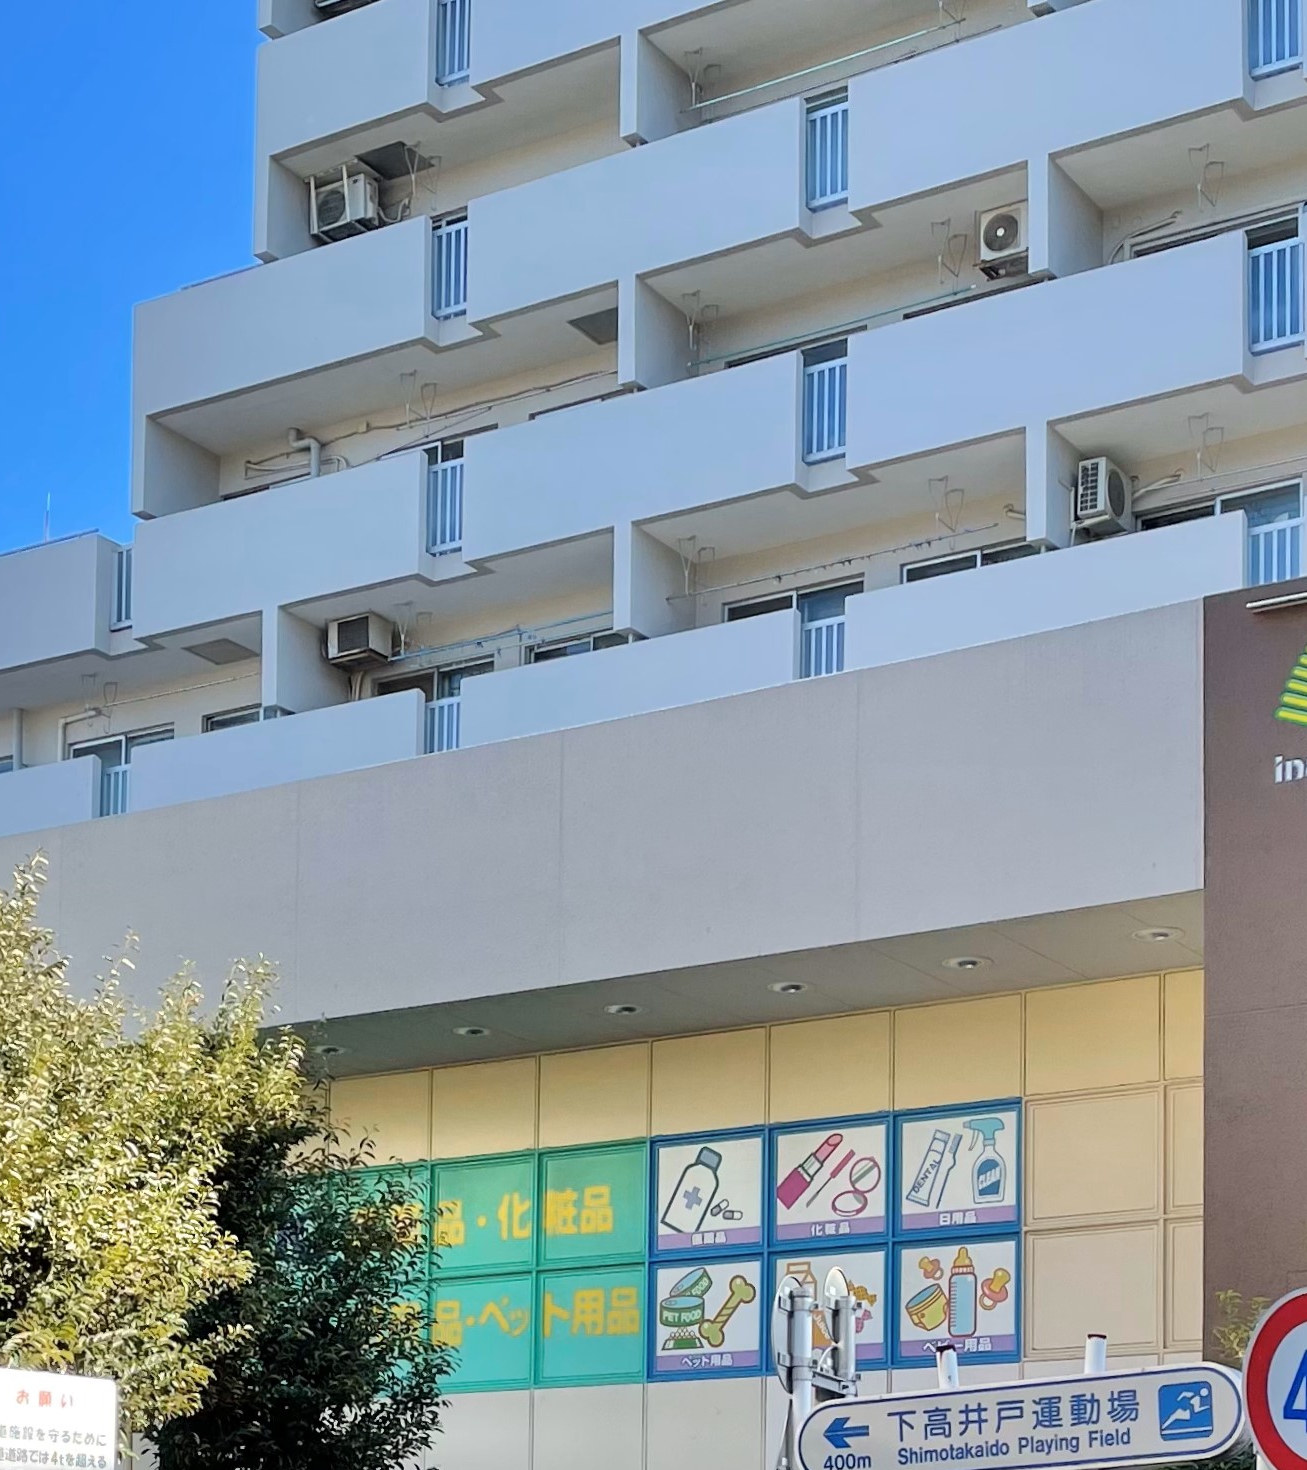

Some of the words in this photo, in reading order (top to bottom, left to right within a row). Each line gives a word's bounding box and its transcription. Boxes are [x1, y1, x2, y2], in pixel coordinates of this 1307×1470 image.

[912, 1159, 942, 1195] DENTAL
[939, 1211, 977, 1225] 日用品
[810, 1221, 850, 1236] 化粧品
[662, 1310, 680, 1322] PET
[681, 1309, 701, 1322] FOOD
[682, 1353, 733, 1367] ペット用品
[16, 1389, 74, 1408] お願い
[887, 1389, 1140, 1443] 下高井戸運動場
[897, 1439, 1010, 1466] Shimotakaido
[1018, 1434, 1080, 1455] Playing
[1089, 1428, 1131, 1447] Field
